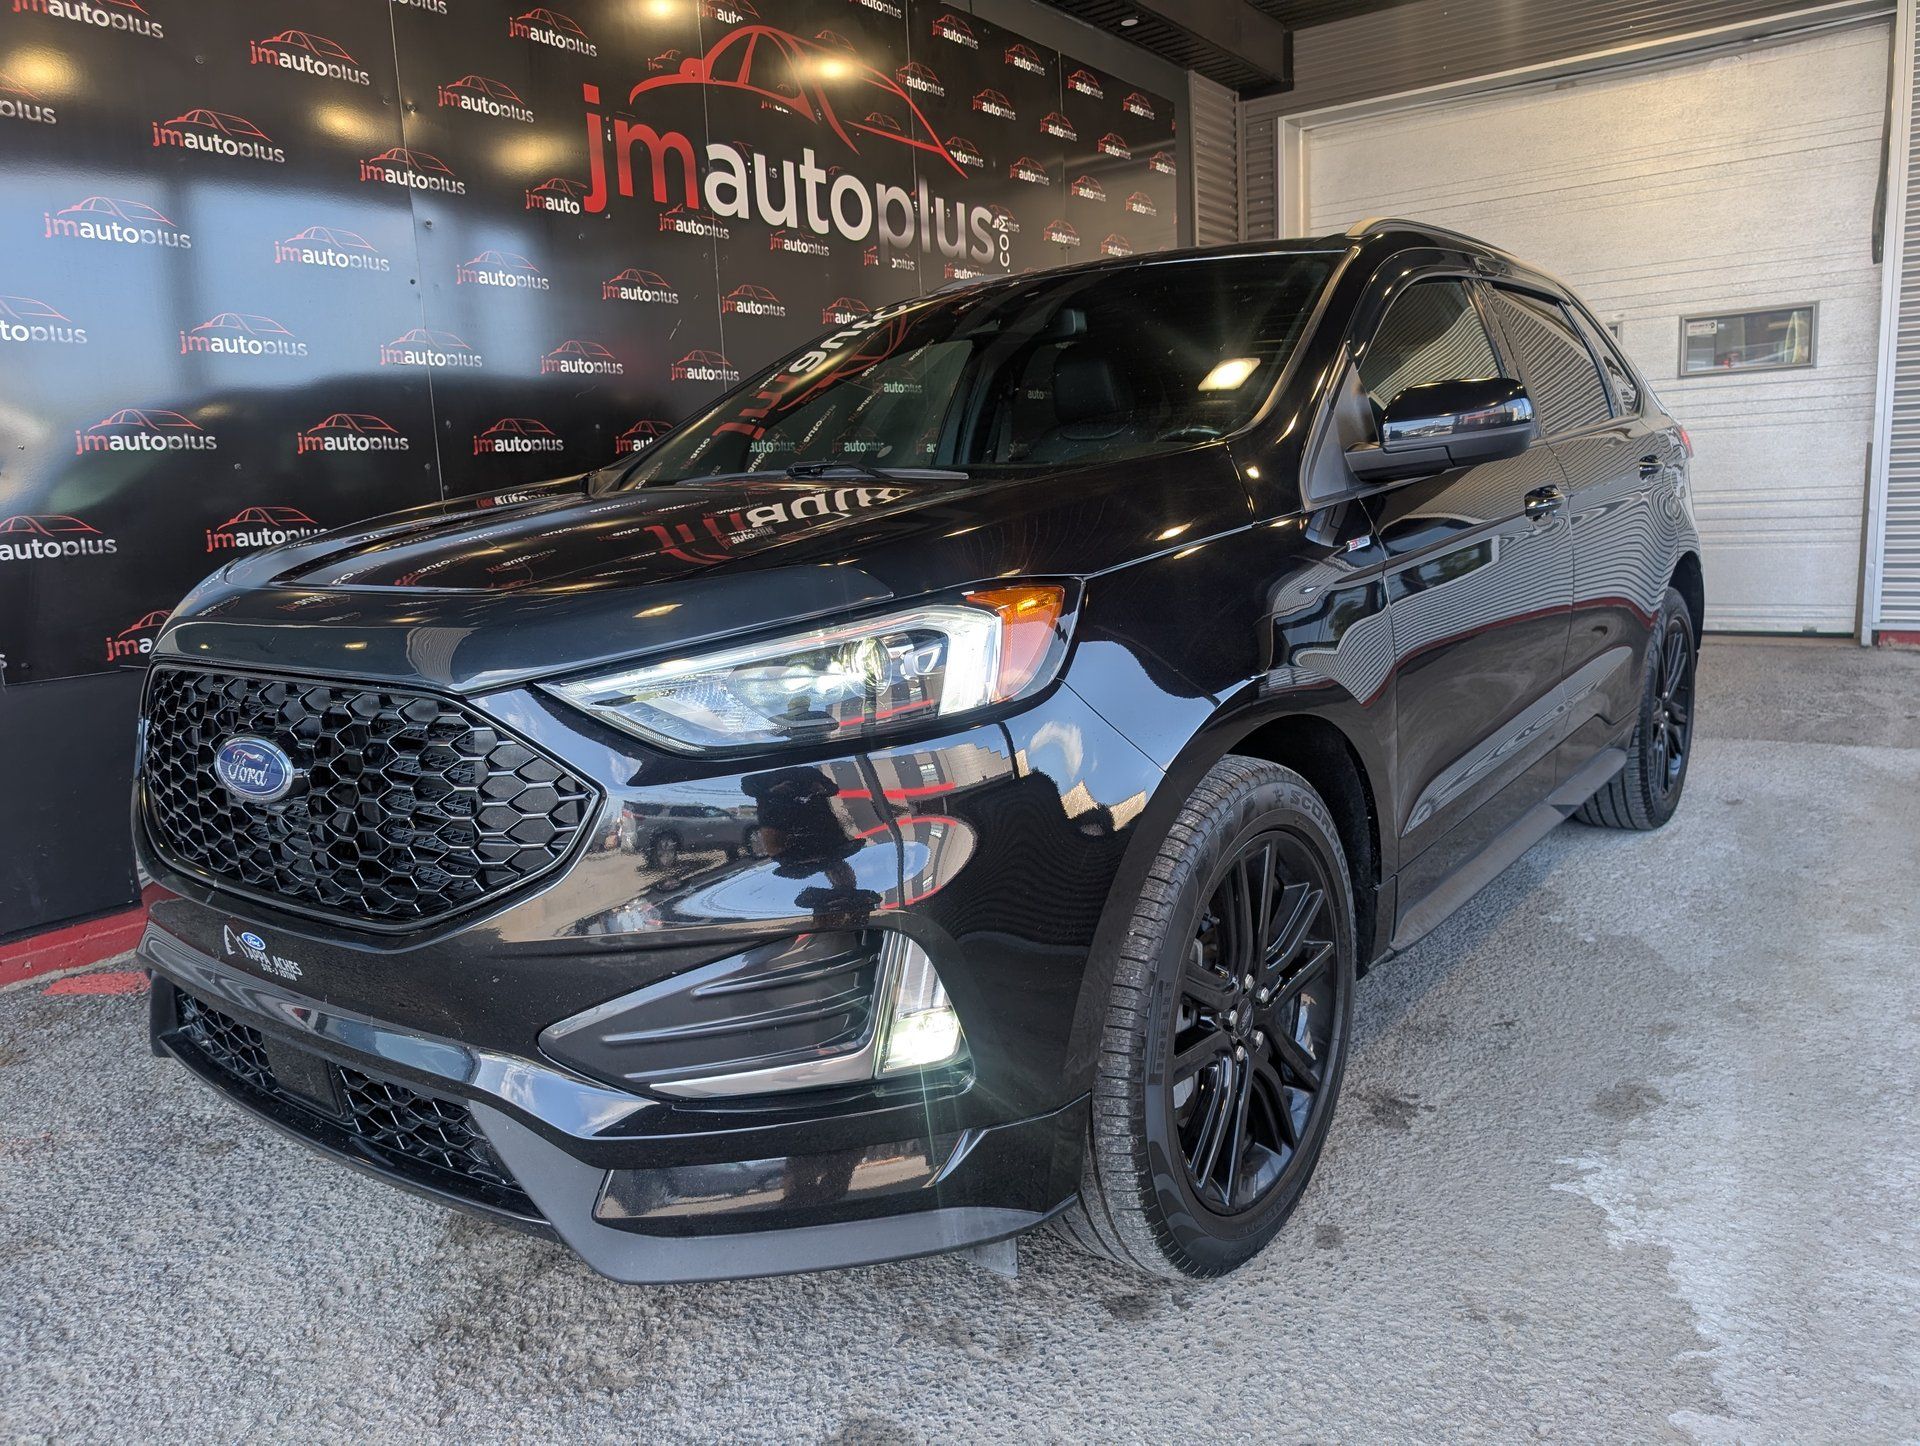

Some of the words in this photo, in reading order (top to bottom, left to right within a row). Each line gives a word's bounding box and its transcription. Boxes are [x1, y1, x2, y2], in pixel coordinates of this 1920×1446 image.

[509, 17, 598, 57] jmautoplus
[932, 20, 979, 50] jmautoplus
[250, 41, 370, 86] jmautoplus
[438, 86, 534, 123] jmautoplus
[152, 122, 286, 163] jmautoplus
[360, 160, 466, 194] jmautoplus
[583, 83, 995, 266] jmautoplus
[45, 213, 192, 249] jmautoplus
[659, 214, 730, 240] jmautoplus
[274, 241, 390, 272] jmautoplus
[770, 233, 830, 256] jmautoplus
[456, 265, 550, 290] jmautoplus
[602, 282, 679, 305] jmautoplus
[722, 297, 786, 317] jmautoplus
[180, 331, 308, 358] jmautoplus
[380, 345, 482, 368] jmautoplus
[540, 355, 624, 376] jmautoplus
[671, 364, 740, 382] jmautoplus
[75, 430, 218, 456] jmautoplus
[297, 432, 410, 455] jmautoplus
[473, 435, 564, 455] jmautoplus
[229, 750, 268, 787] Ford
